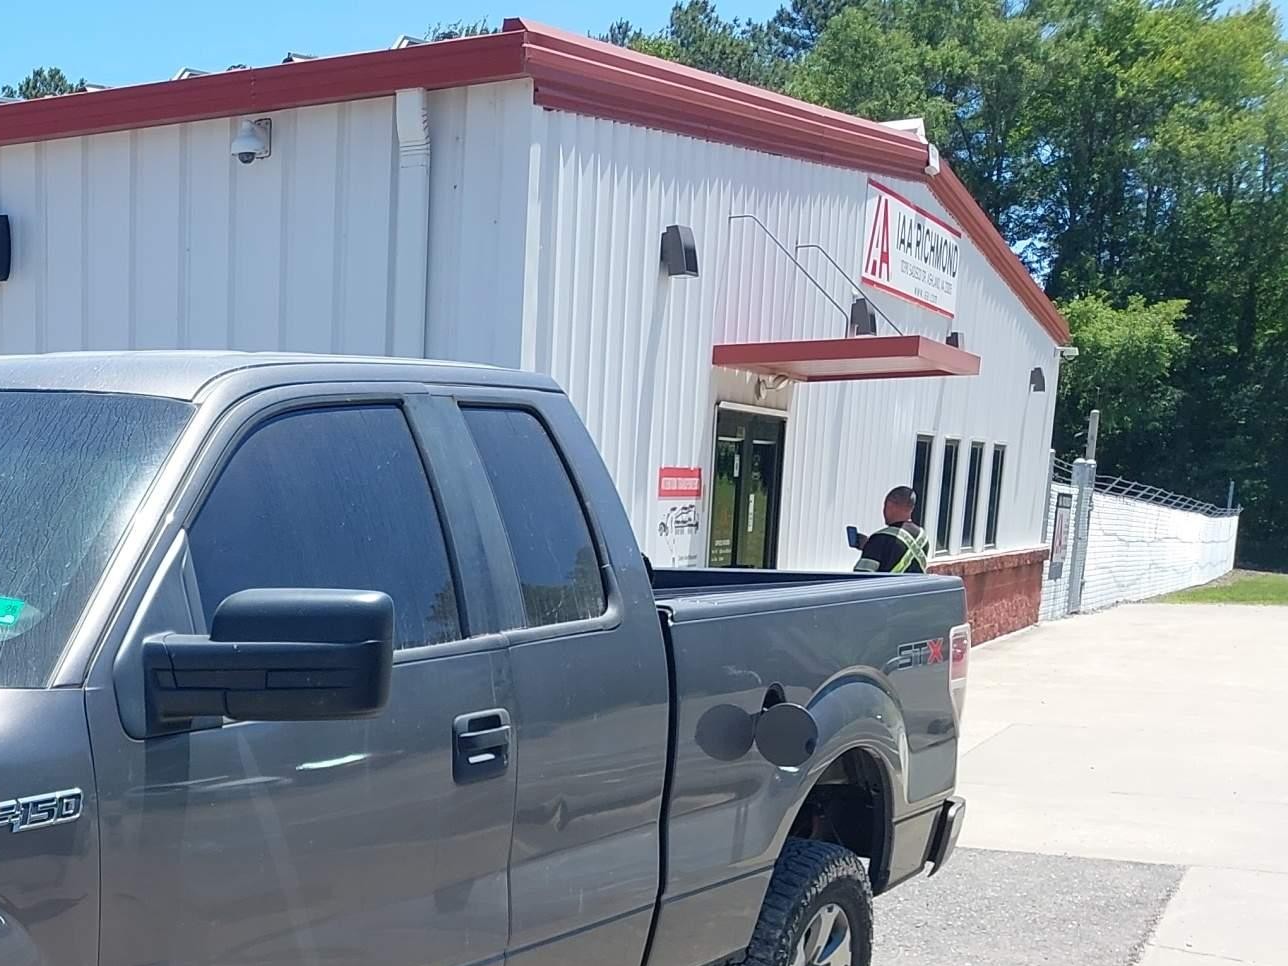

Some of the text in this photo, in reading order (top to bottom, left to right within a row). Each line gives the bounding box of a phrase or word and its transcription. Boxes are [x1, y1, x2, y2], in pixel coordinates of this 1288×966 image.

[896, 212, 913, 256] IAA
[915, 223, 958, 278] RICHMOND
[897, 637, 944, 671] STX
